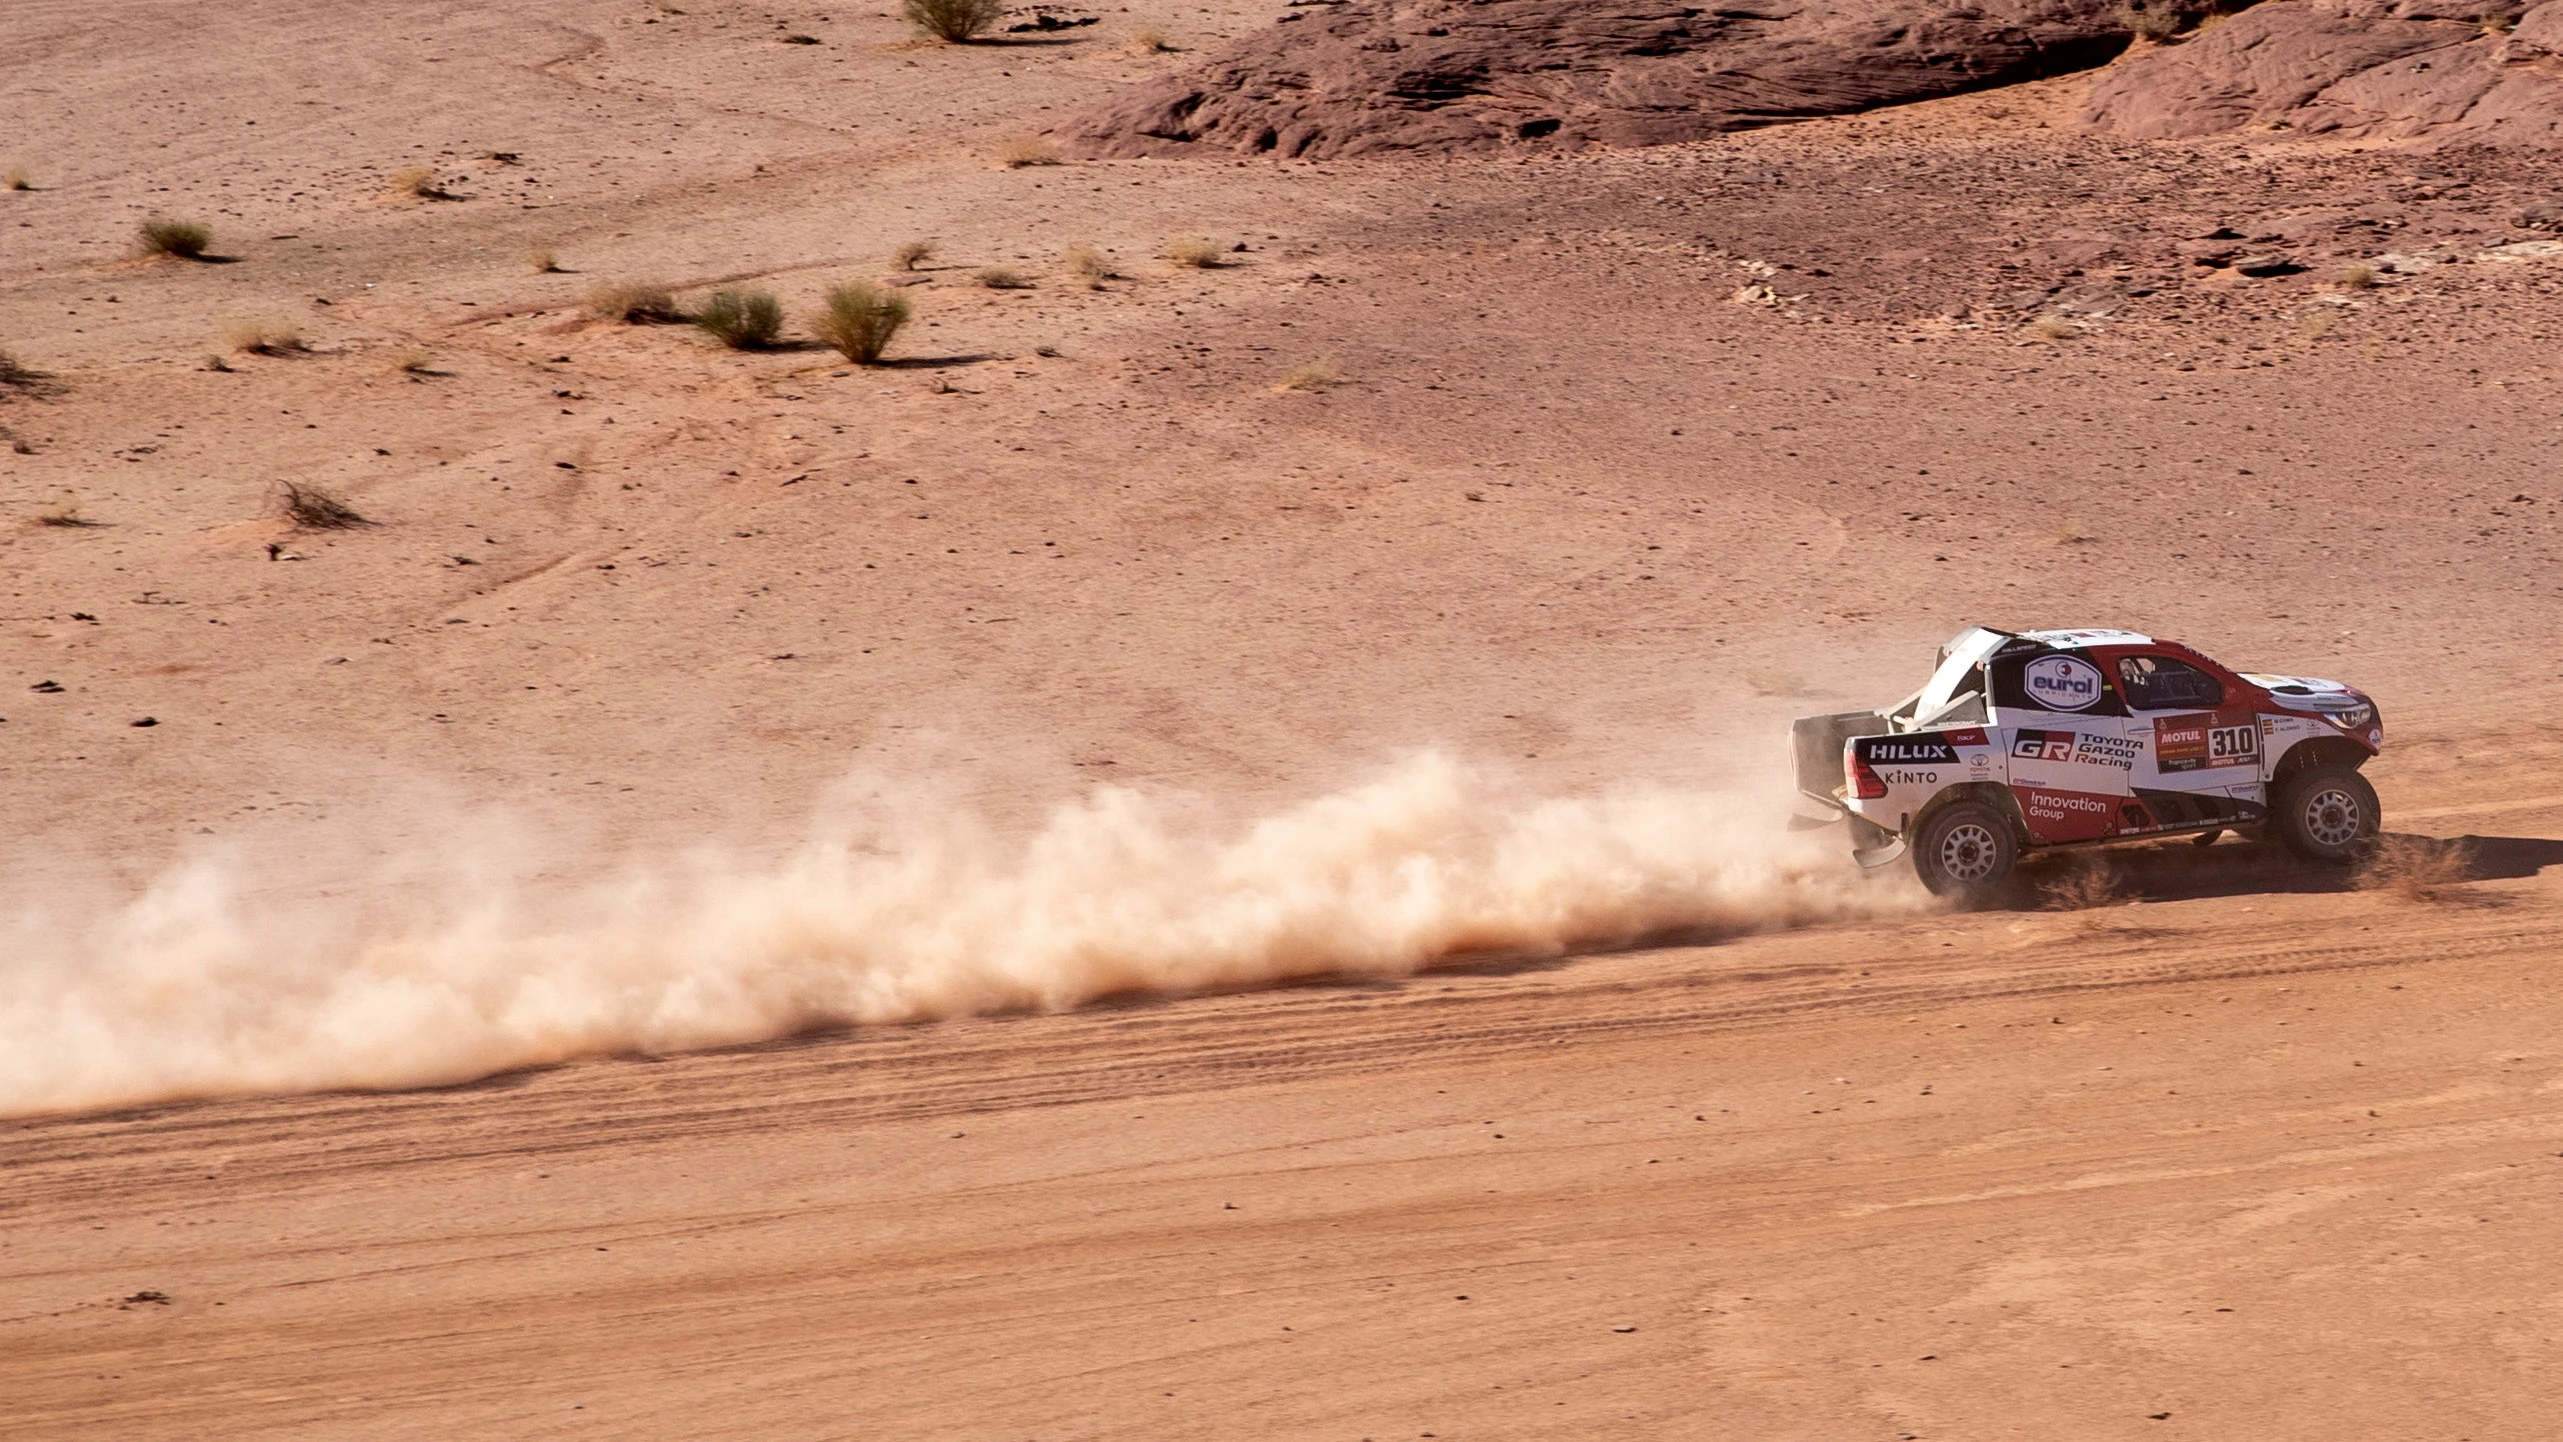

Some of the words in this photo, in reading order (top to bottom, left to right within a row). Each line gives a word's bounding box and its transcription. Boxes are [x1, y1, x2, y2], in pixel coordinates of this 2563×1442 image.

[2034, 676, 2093, 694] eurol
[2080, 733, 2144, 749] TOYOTA
[2161, 730, 2201, 744] MOTUL
[2212, 727, 2253, 756] 310
[1870, 745, 1948, 759] HILUX
[2014, 740, 2071, 760] GR
[2078, 743, 2136, 758] GAZOO
[2074, 753, 2133, 771] Racing
[2031, 792, 2107, 813] Innovation
[2029, 806, 2065, 820] Group
